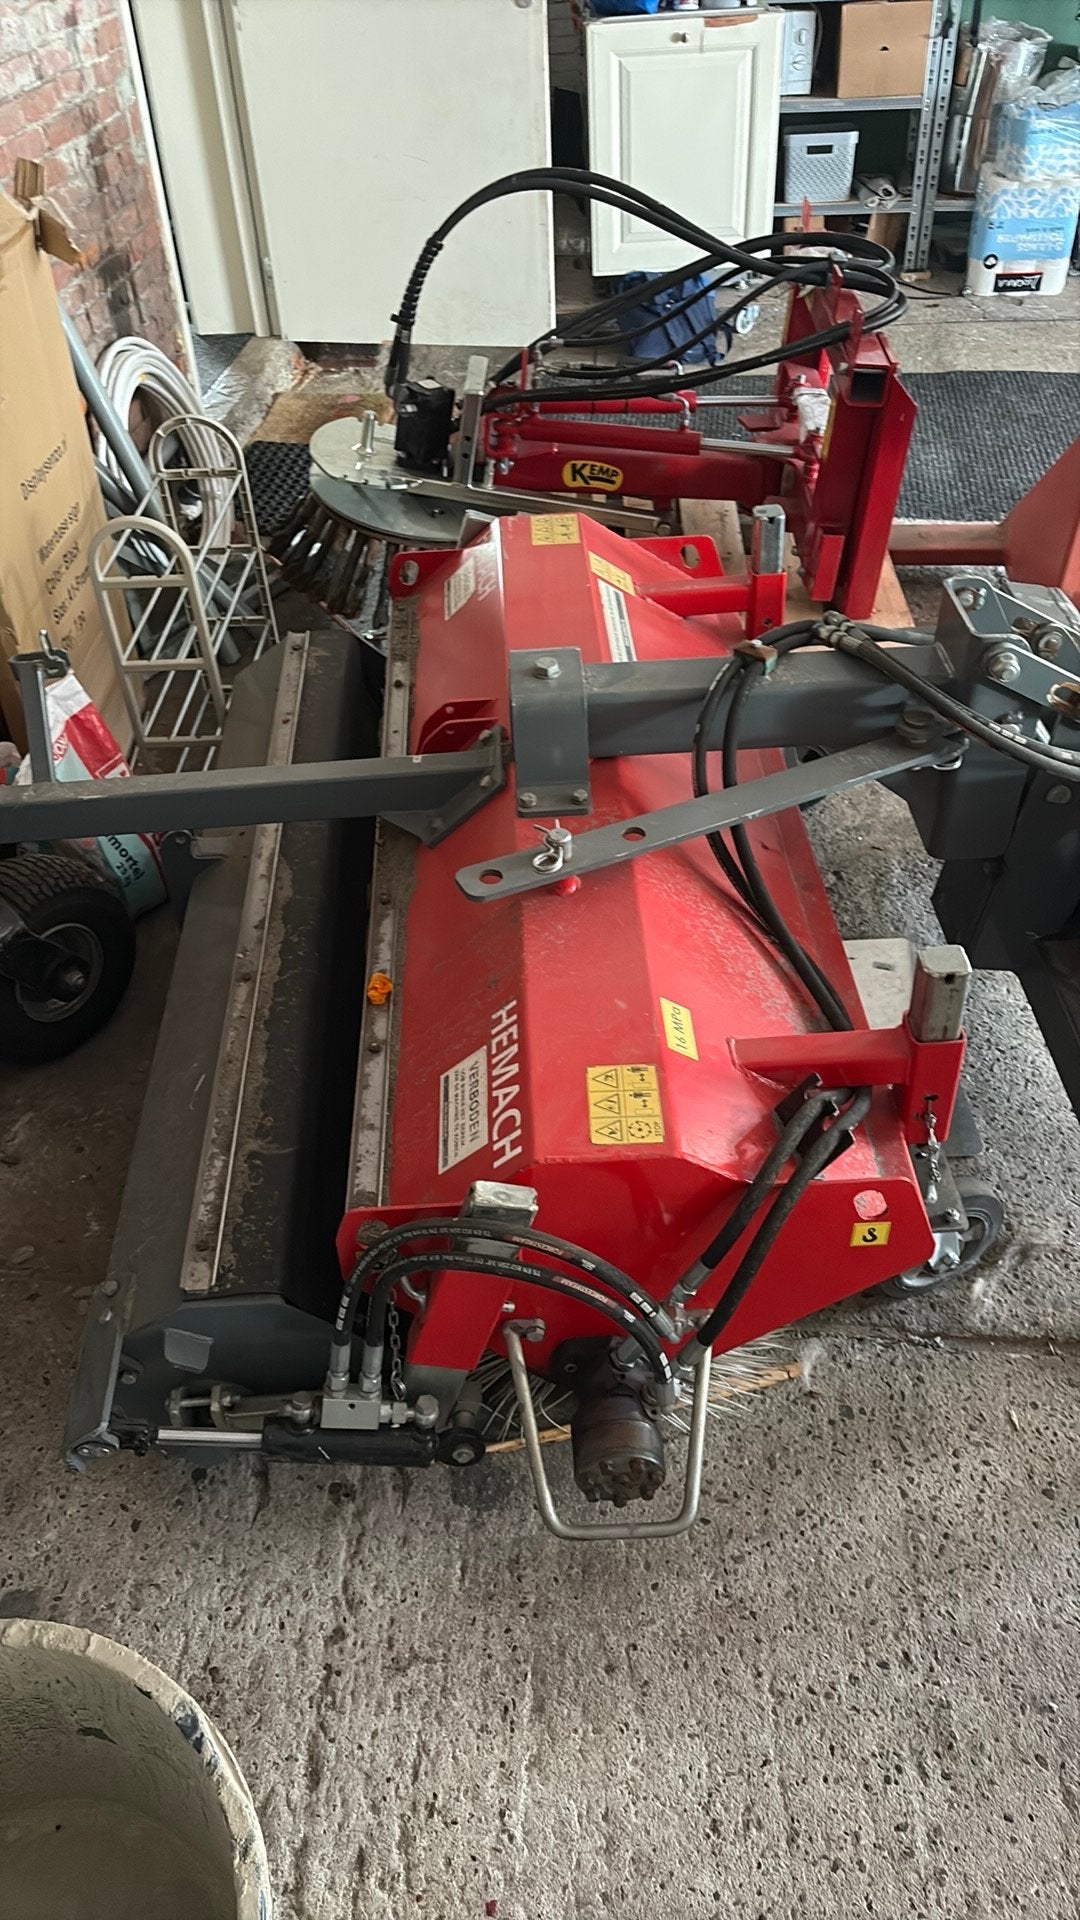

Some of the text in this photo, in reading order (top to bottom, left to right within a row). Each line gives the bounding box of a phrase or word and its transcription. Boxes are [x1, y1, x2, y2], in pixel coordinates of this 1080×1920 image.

[571, 463, 619, 485] KEMP
[106, 836, 145, 880] mortel
[116, 862, 128, 876] 25
[671, 1006, 688, 1050] 16 MPa
[491, 1000, 523, 1169] HEMACH
[468, 1061, 480, 1143] VERBODEN
[653, 1121, 662, 1137] STOP
[862, 1227, 878, 1243] S
